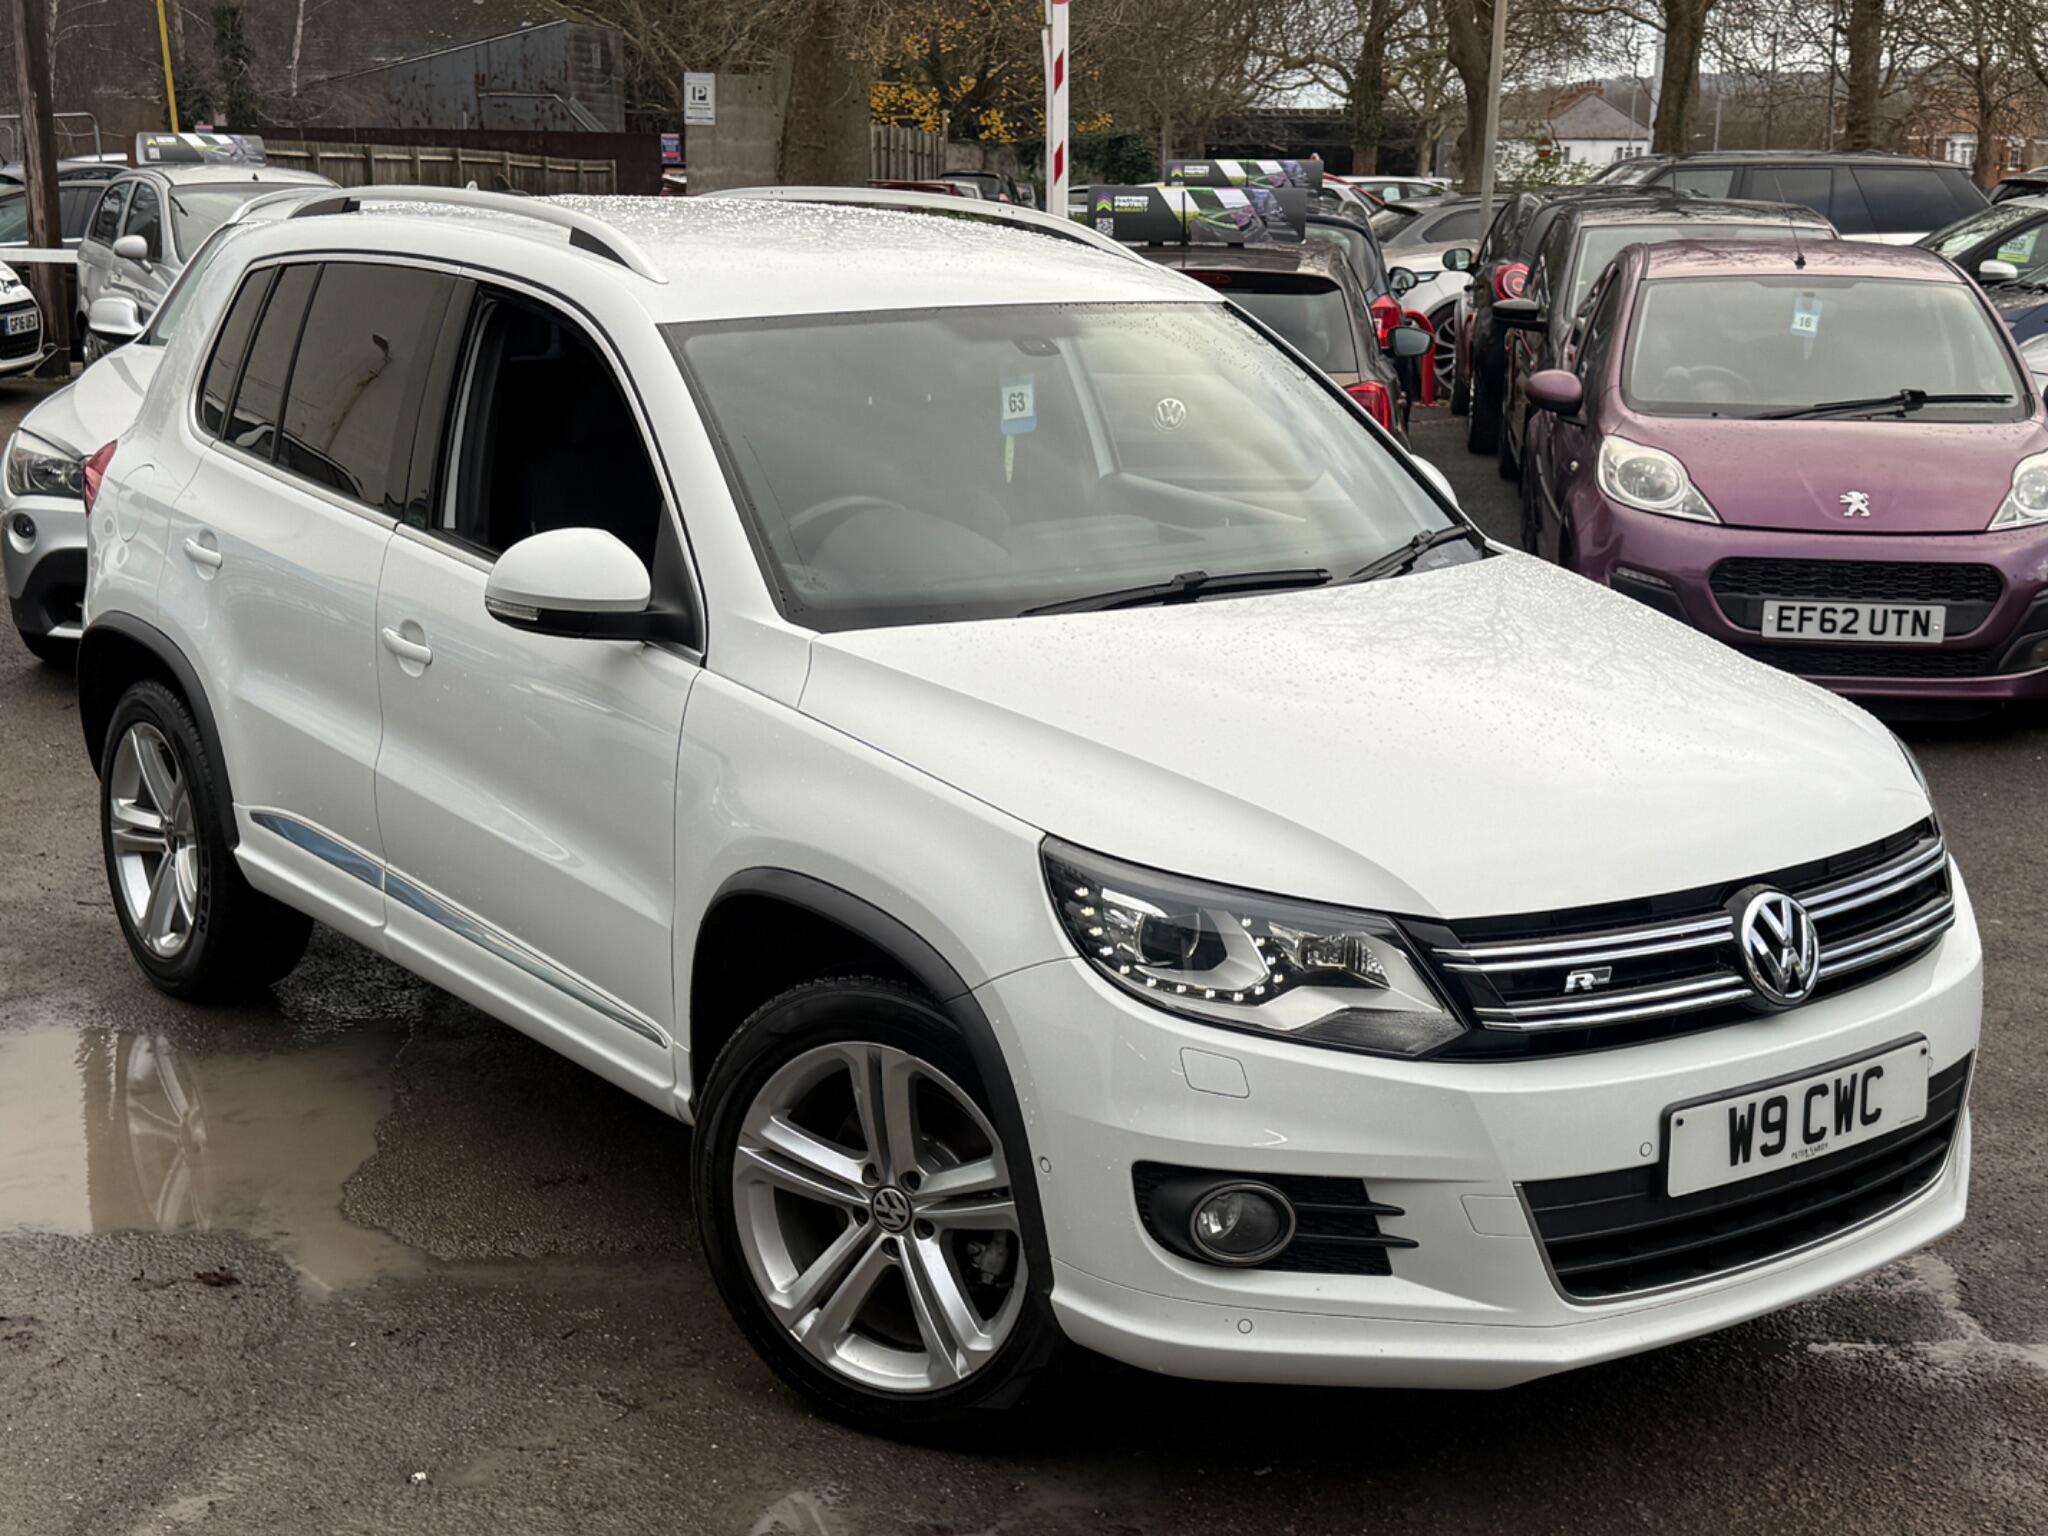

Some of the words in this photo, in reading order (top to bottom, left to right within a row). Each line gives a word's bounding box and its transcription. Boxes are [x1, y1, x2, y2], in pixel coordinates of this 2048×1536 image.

[1800, 316, 1812, 328] 16
[1008, 391, 1026, 412] 63
[1776, 605, 1860, 635] EF62
[1868, 608, 1932, 637] UTN
[1564, 969, 1599, 993] R
[1728, 1094, 1788, 1167] W9
[1802, 1065, 1884, 1145] CWC
